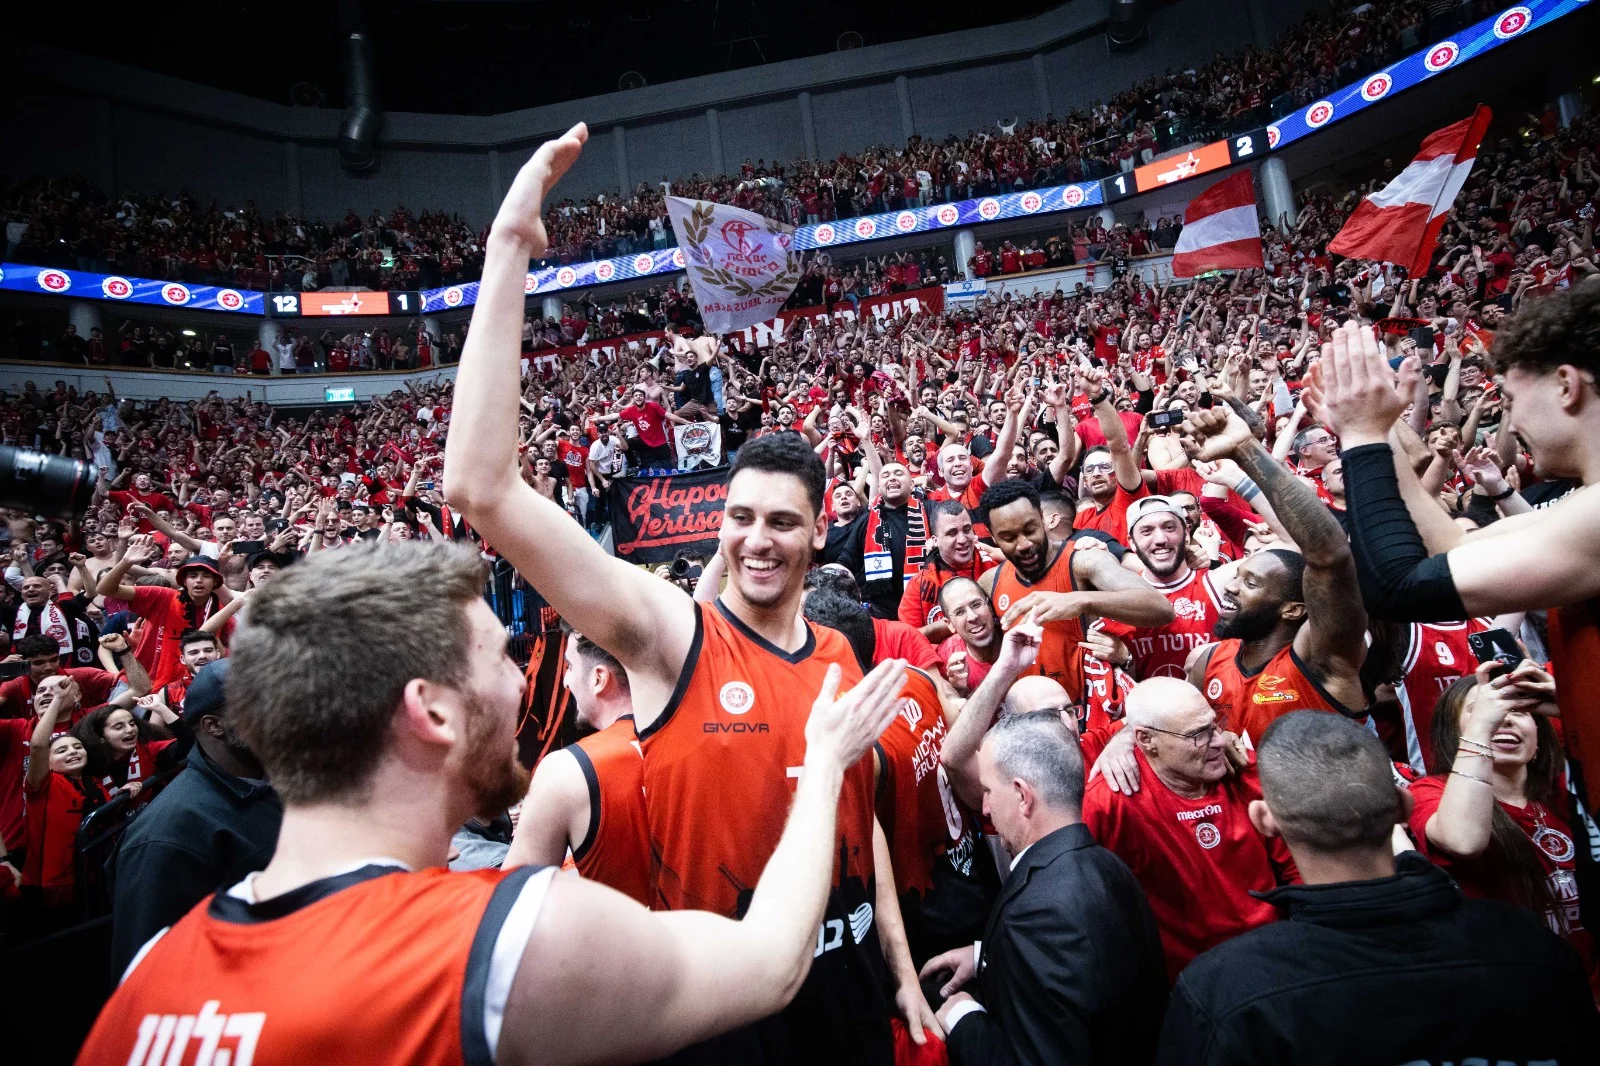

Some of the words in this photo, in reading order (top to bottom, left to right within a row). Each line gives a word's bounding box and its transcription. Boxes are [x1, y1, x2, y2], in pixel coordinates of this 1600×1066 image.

[1236, 136, 1254, 157] 2
[1114, 176, 1127, 194] 1
[272, 295, 298, 312] 12
[397, 294, 408, 311] 1
[627, 478, 728, 523] Hapo
[1435, 641, 1455, 666] 9
[703, 722, 770, 733] GIVOVA
[1176, 804, 1223, 821] macron
